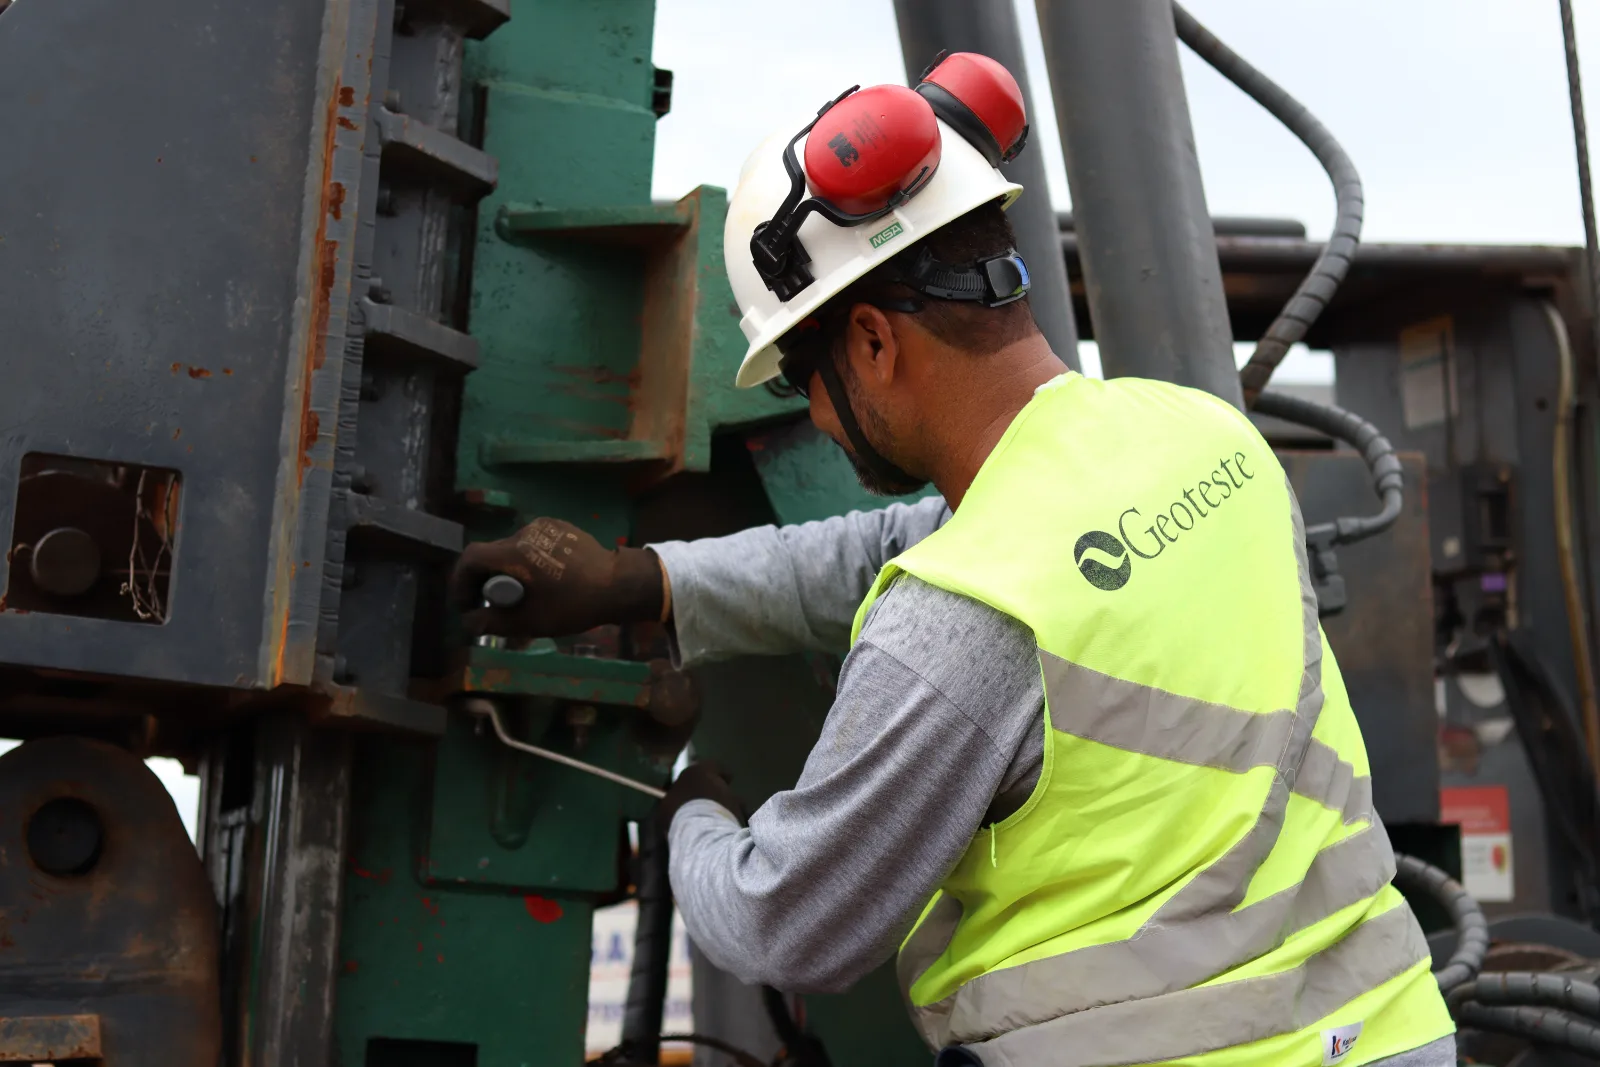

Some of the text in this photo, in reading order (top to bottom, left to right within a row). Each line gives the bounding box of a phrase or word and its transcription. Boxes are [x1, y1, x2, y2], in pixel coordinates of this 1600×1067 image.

[828, 132, 859, 167] 3M
[872, 224, 902, 246] MSA
[1118, 452, 1255, 559] Geoteste
